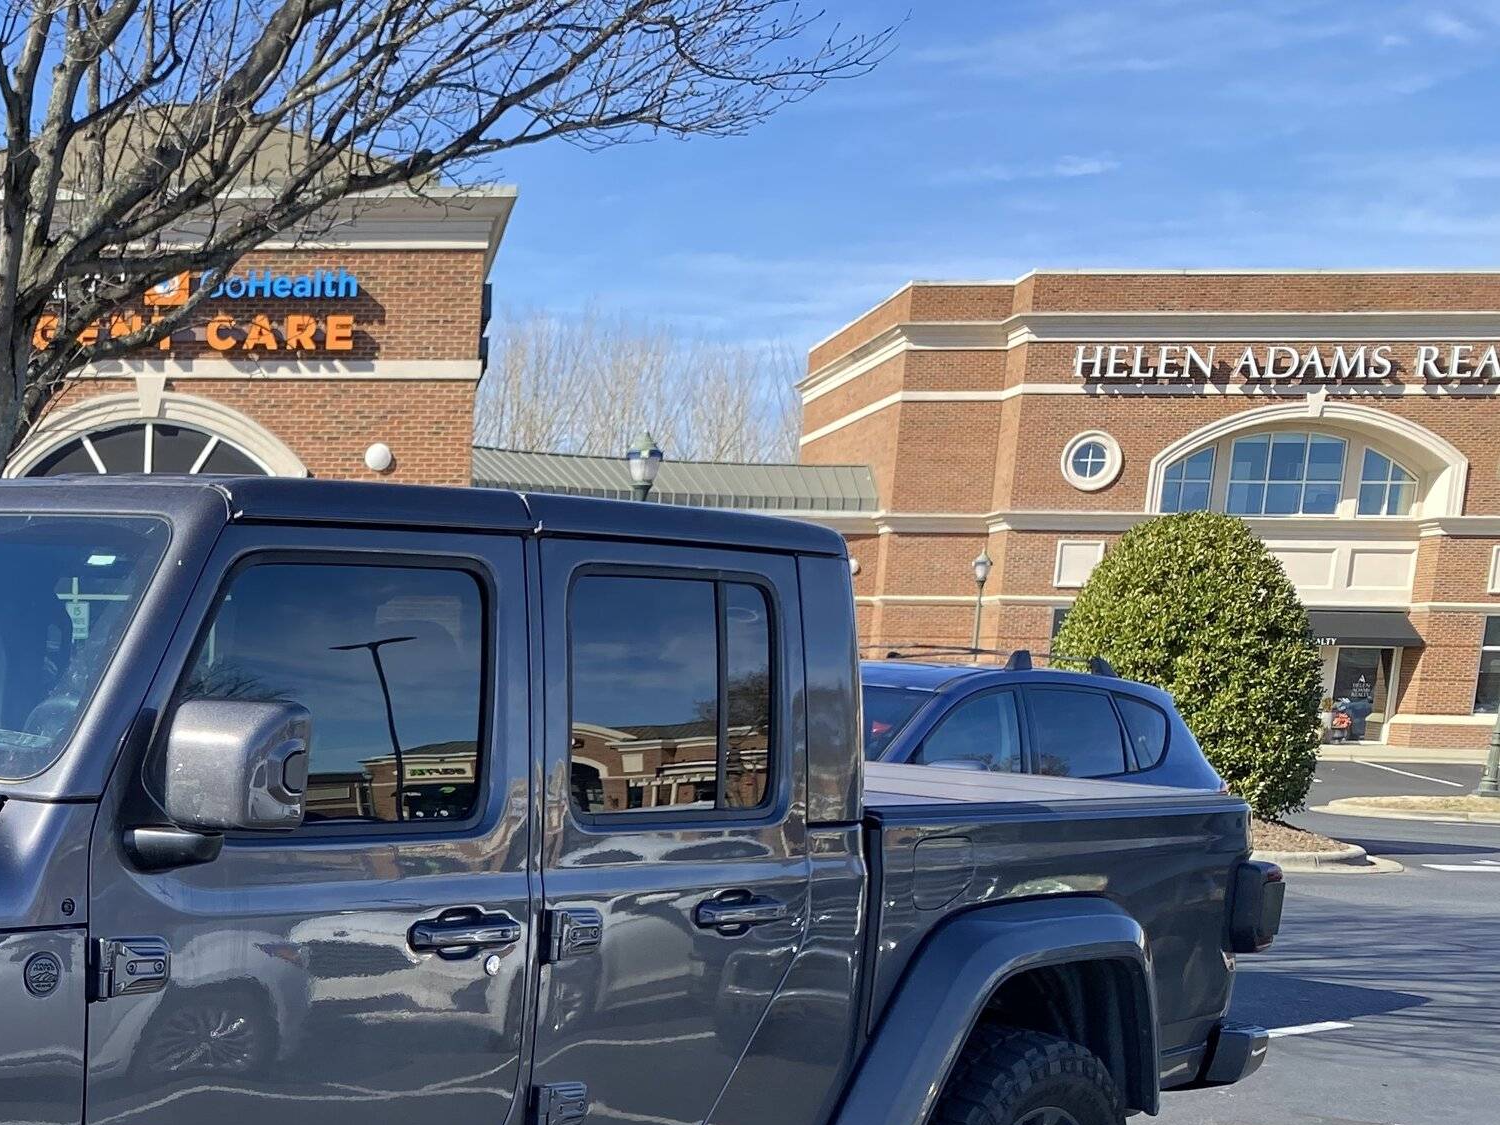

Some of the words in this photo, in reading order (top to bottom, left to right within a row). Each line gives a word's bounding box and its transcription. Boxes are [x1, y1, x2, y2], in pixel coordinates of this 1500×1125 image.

[206, 313, 355, 350] CARE
[1074, 345, 1214, 378] HELEN
[1232, 345, 1392, 379] ADAMS
